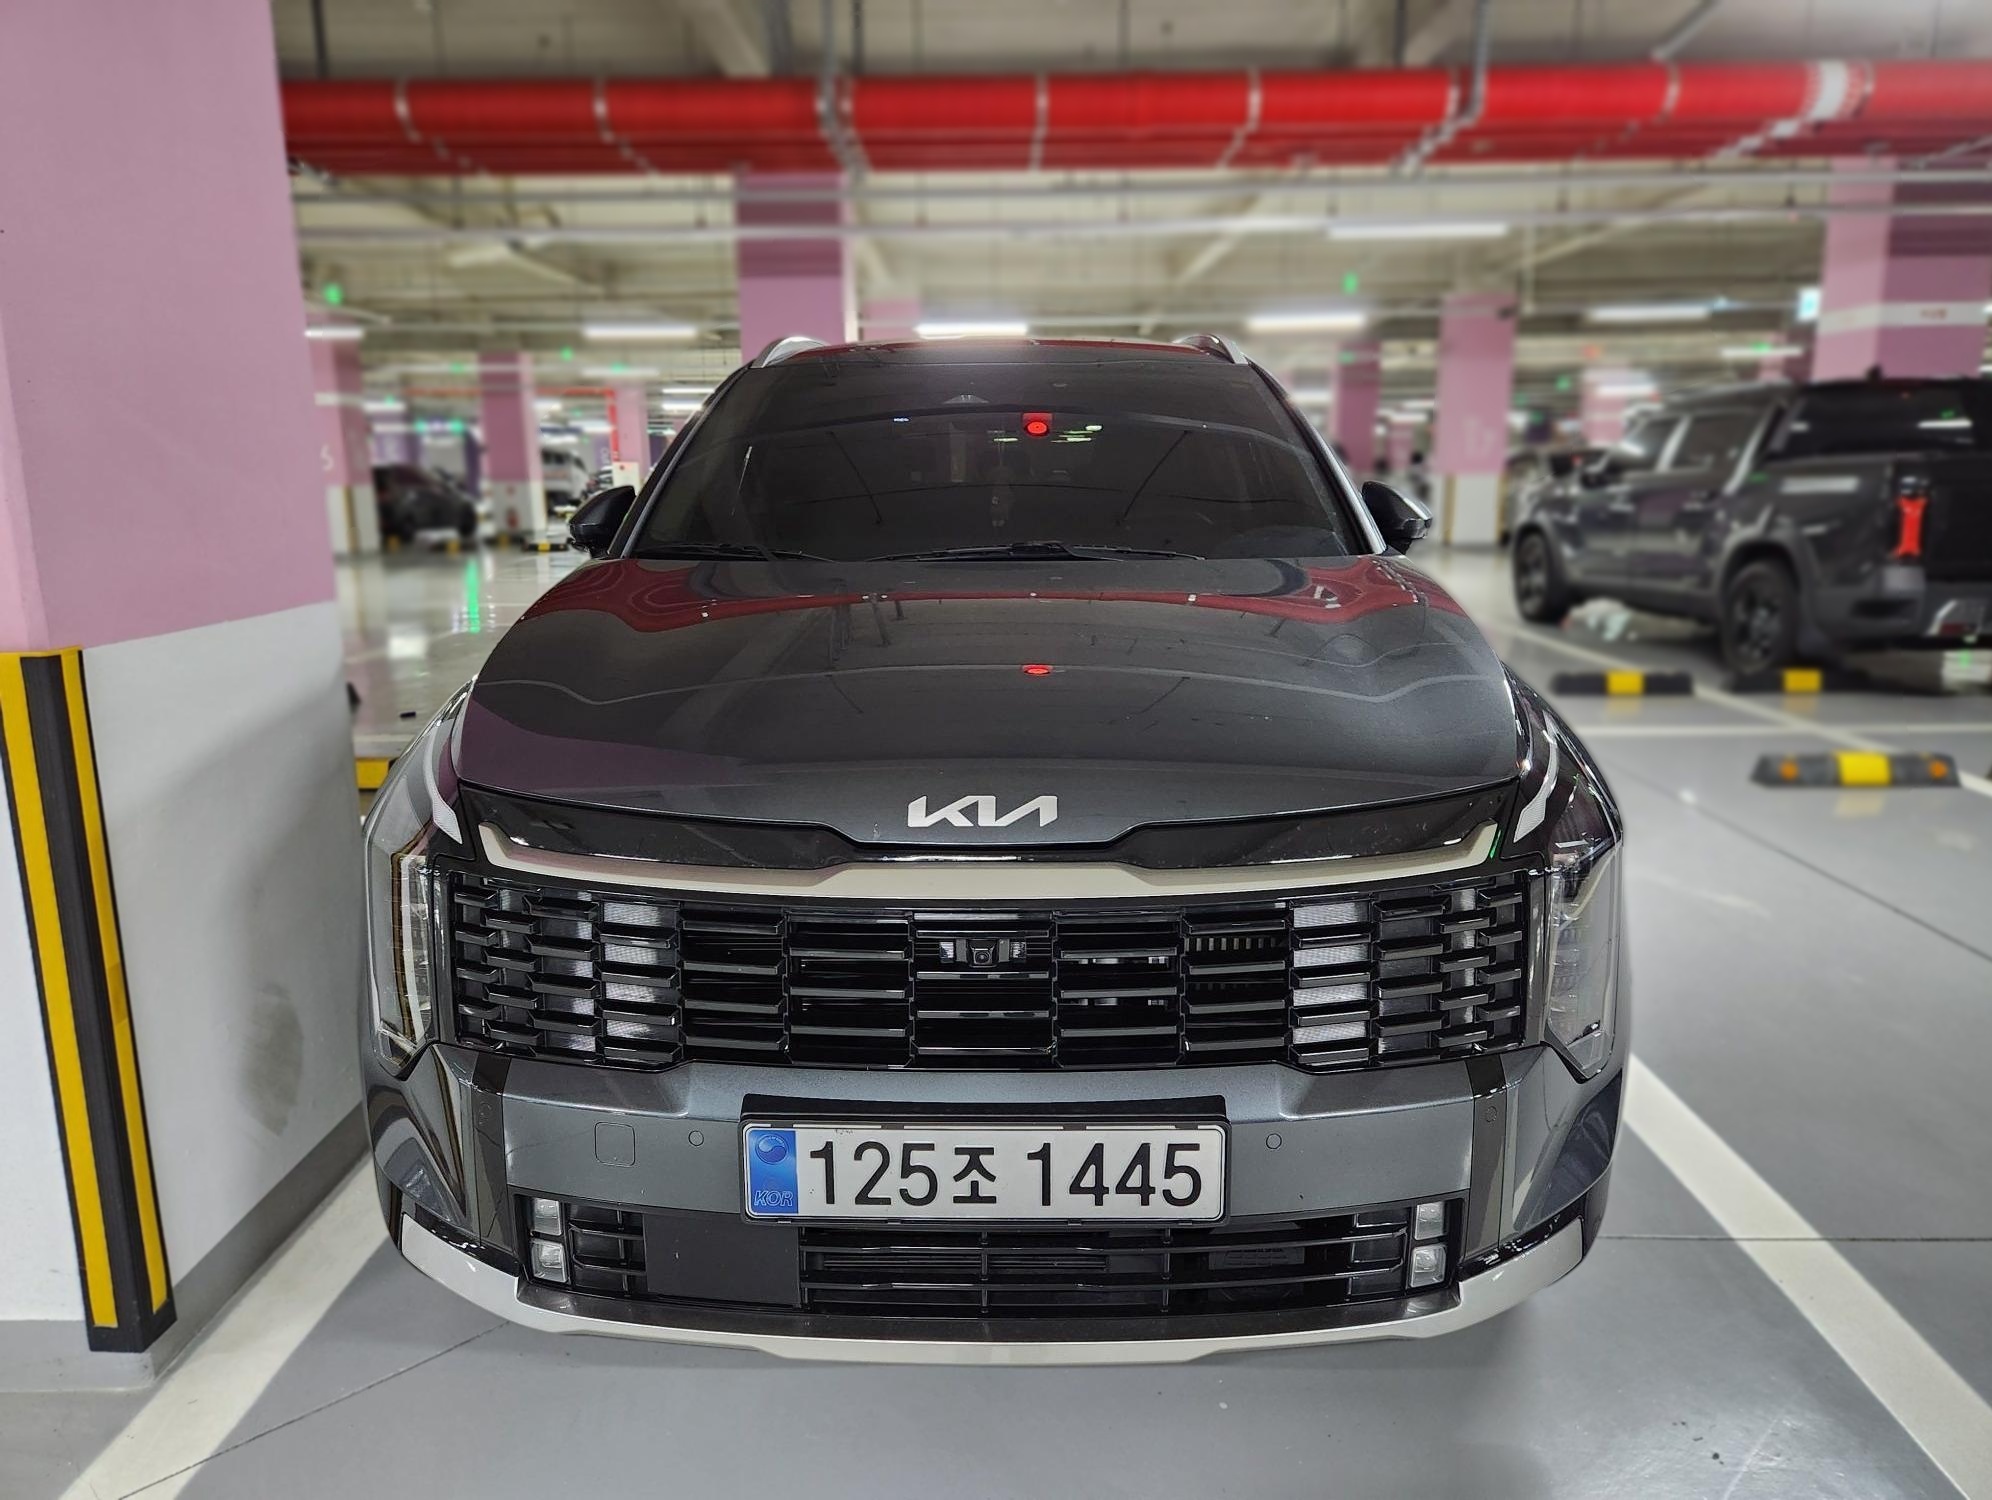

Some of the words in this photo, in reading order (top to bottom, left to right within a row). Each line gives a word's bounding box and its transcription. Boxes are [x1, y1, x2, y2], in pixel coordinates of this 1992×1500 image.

[908, 796, 1057, 827] KIA
[810, 1141, 997, 1206] 125조
[1027, 1143, 1202, 1207] 1445
[753, 1190, 793, 1207] KOR
